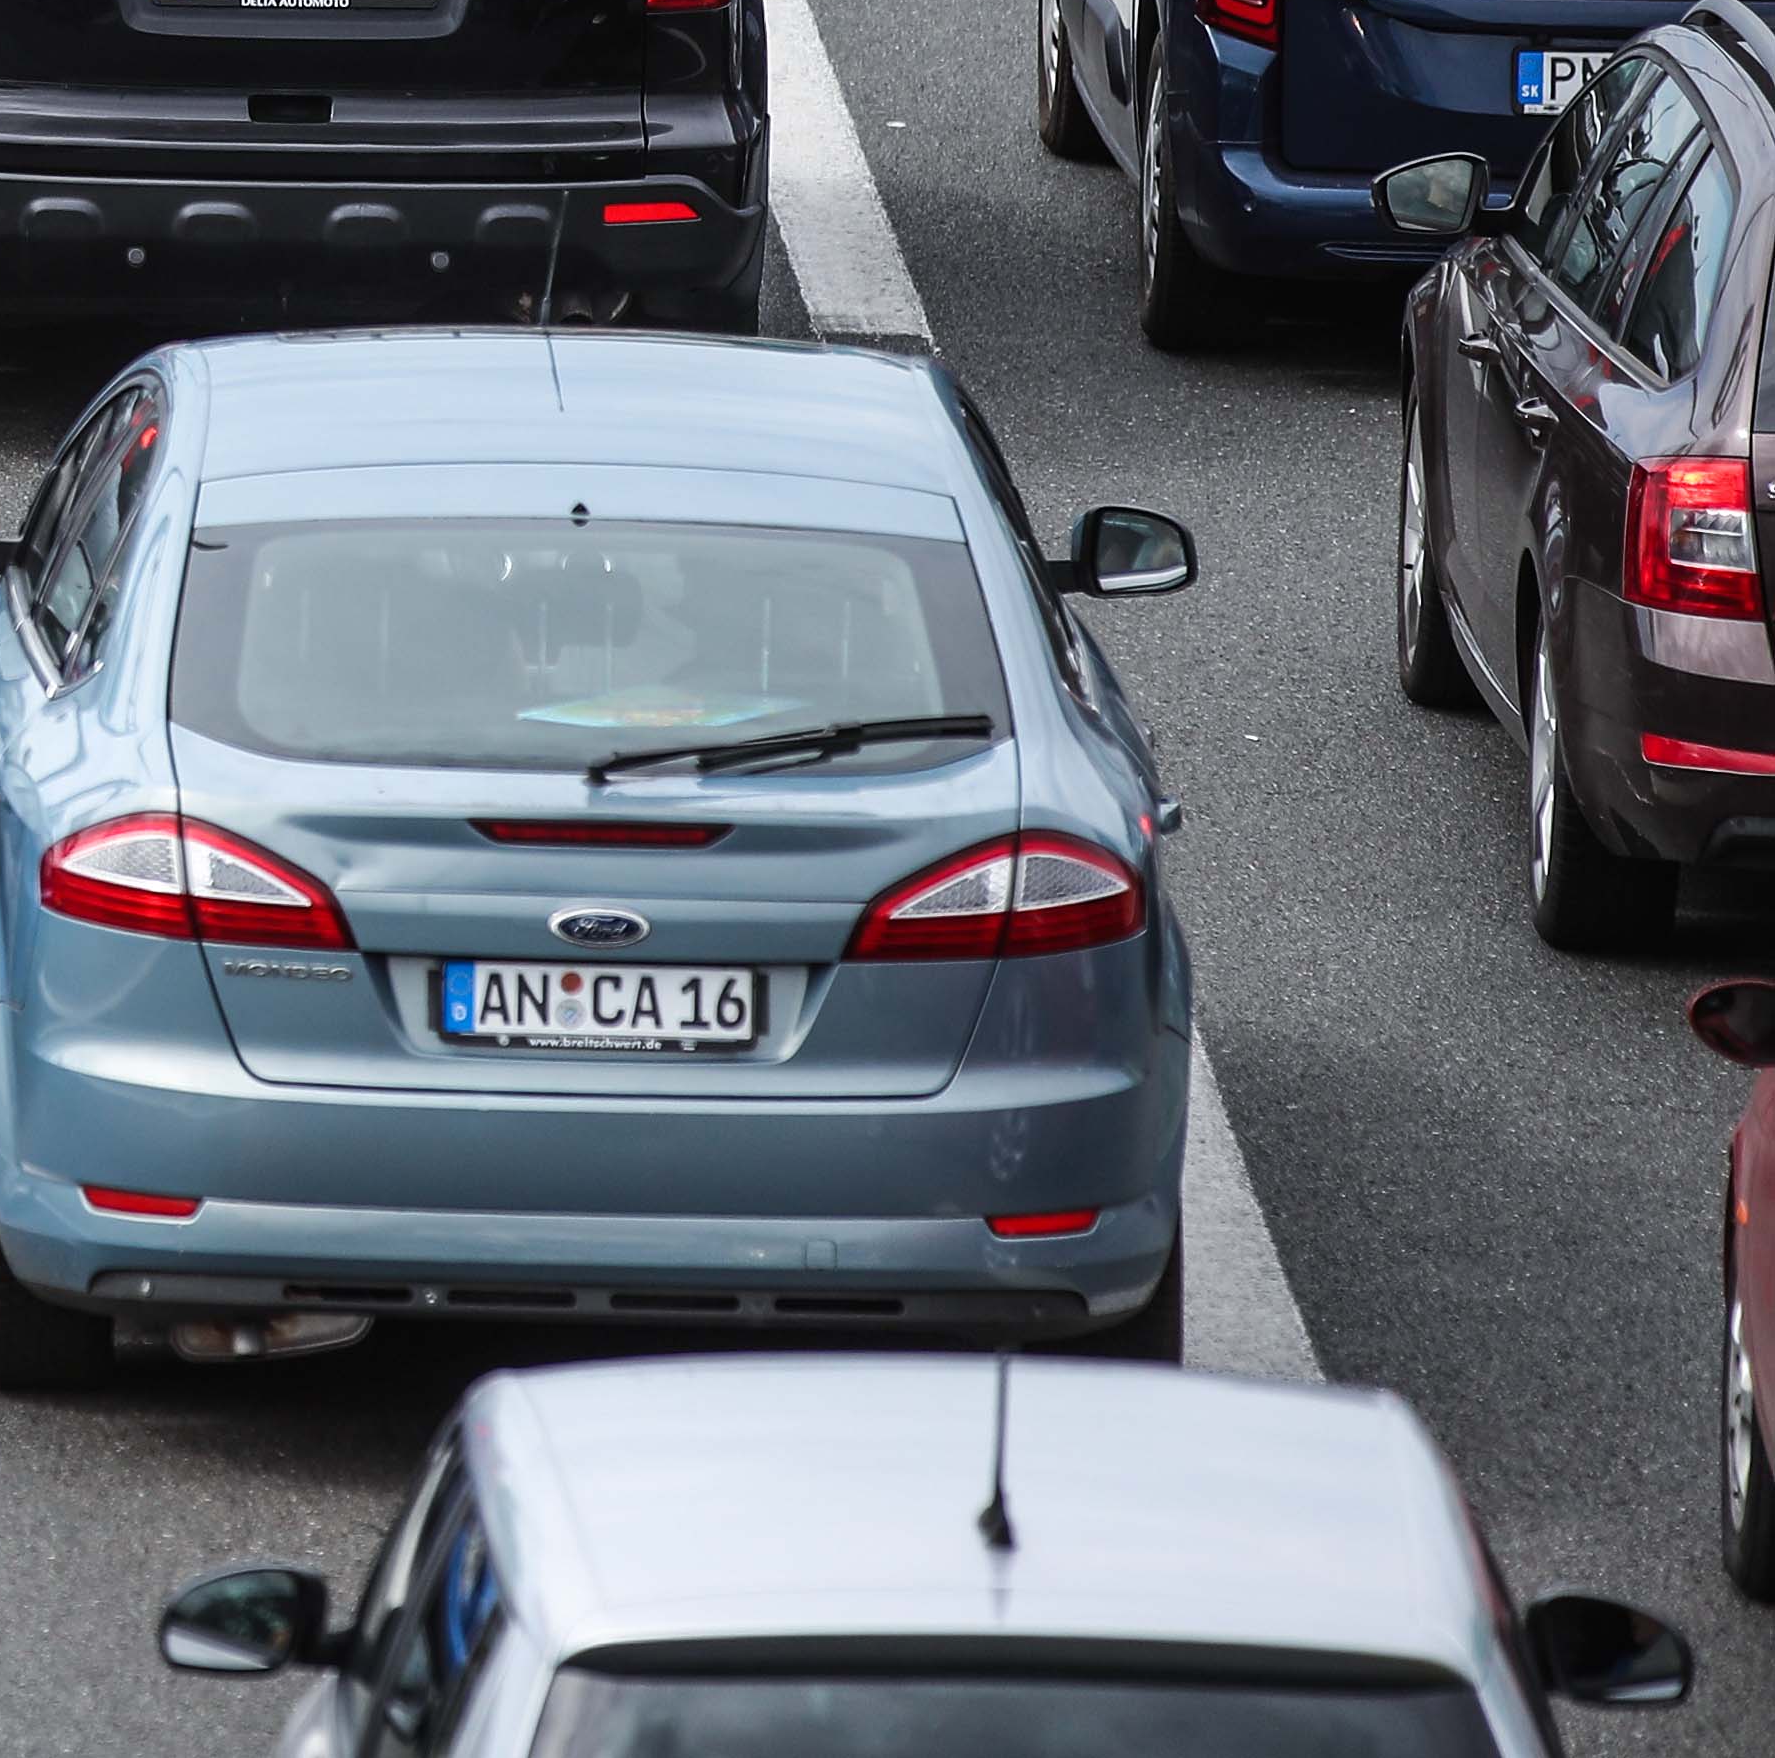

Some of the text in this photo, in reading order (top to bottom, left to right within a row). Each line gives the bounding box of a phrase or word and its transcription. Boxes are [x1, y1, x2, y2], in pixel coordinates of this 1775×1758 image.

[1521, 84, 1539, 98] SK
[573, 915, 629, 939] Ford
[223, 959, 353, 982] MONDEO
[479, 972, 747, 1030] AN CA 16
